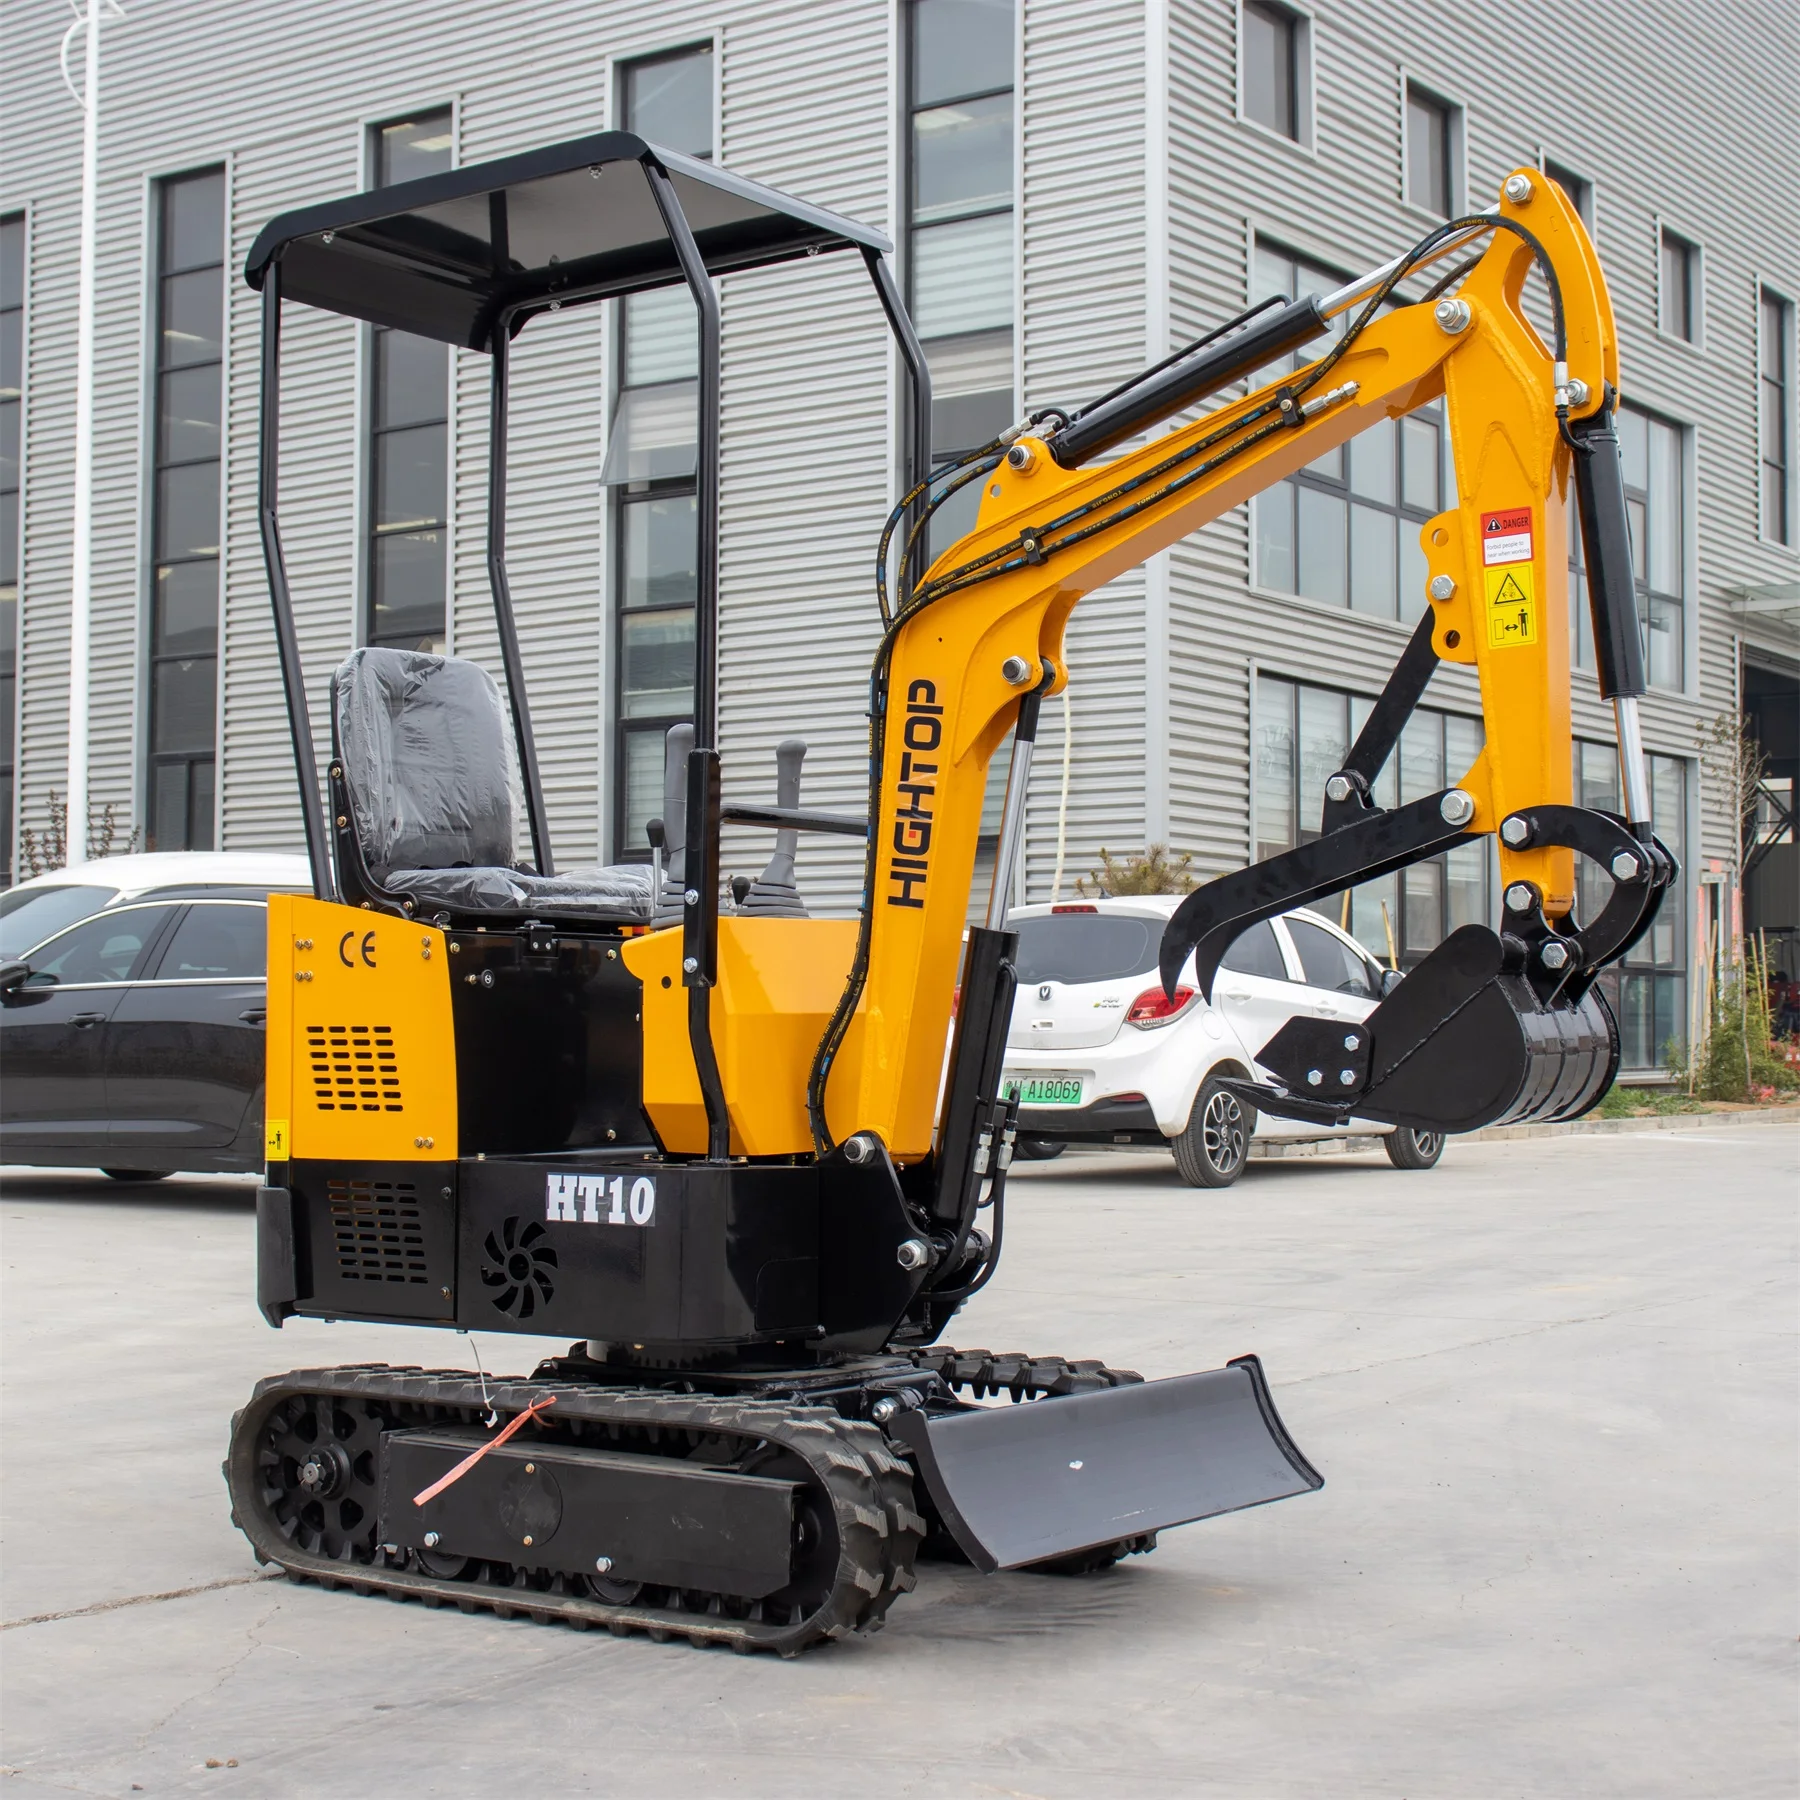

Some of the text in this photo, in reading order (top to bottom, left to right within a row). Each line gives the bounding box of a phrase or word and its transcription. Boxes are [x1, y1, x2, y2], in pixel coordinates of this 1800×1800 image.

[901, 483, 926, 507] YONGJIE
[1091, 489, 1124, 509] YONGJIE
[1136, 487, 1167, 506] YONGJIE
[1503, 516, 1529, 529] DANGER
[1502, 541, 1518, 549] people
[1511, 547, 1530, 555] working
[888, 679, 944, 908] HIGHTOP
[339, 930, 377, 968] CE
[546, 1174, 655, 1225] HT10
